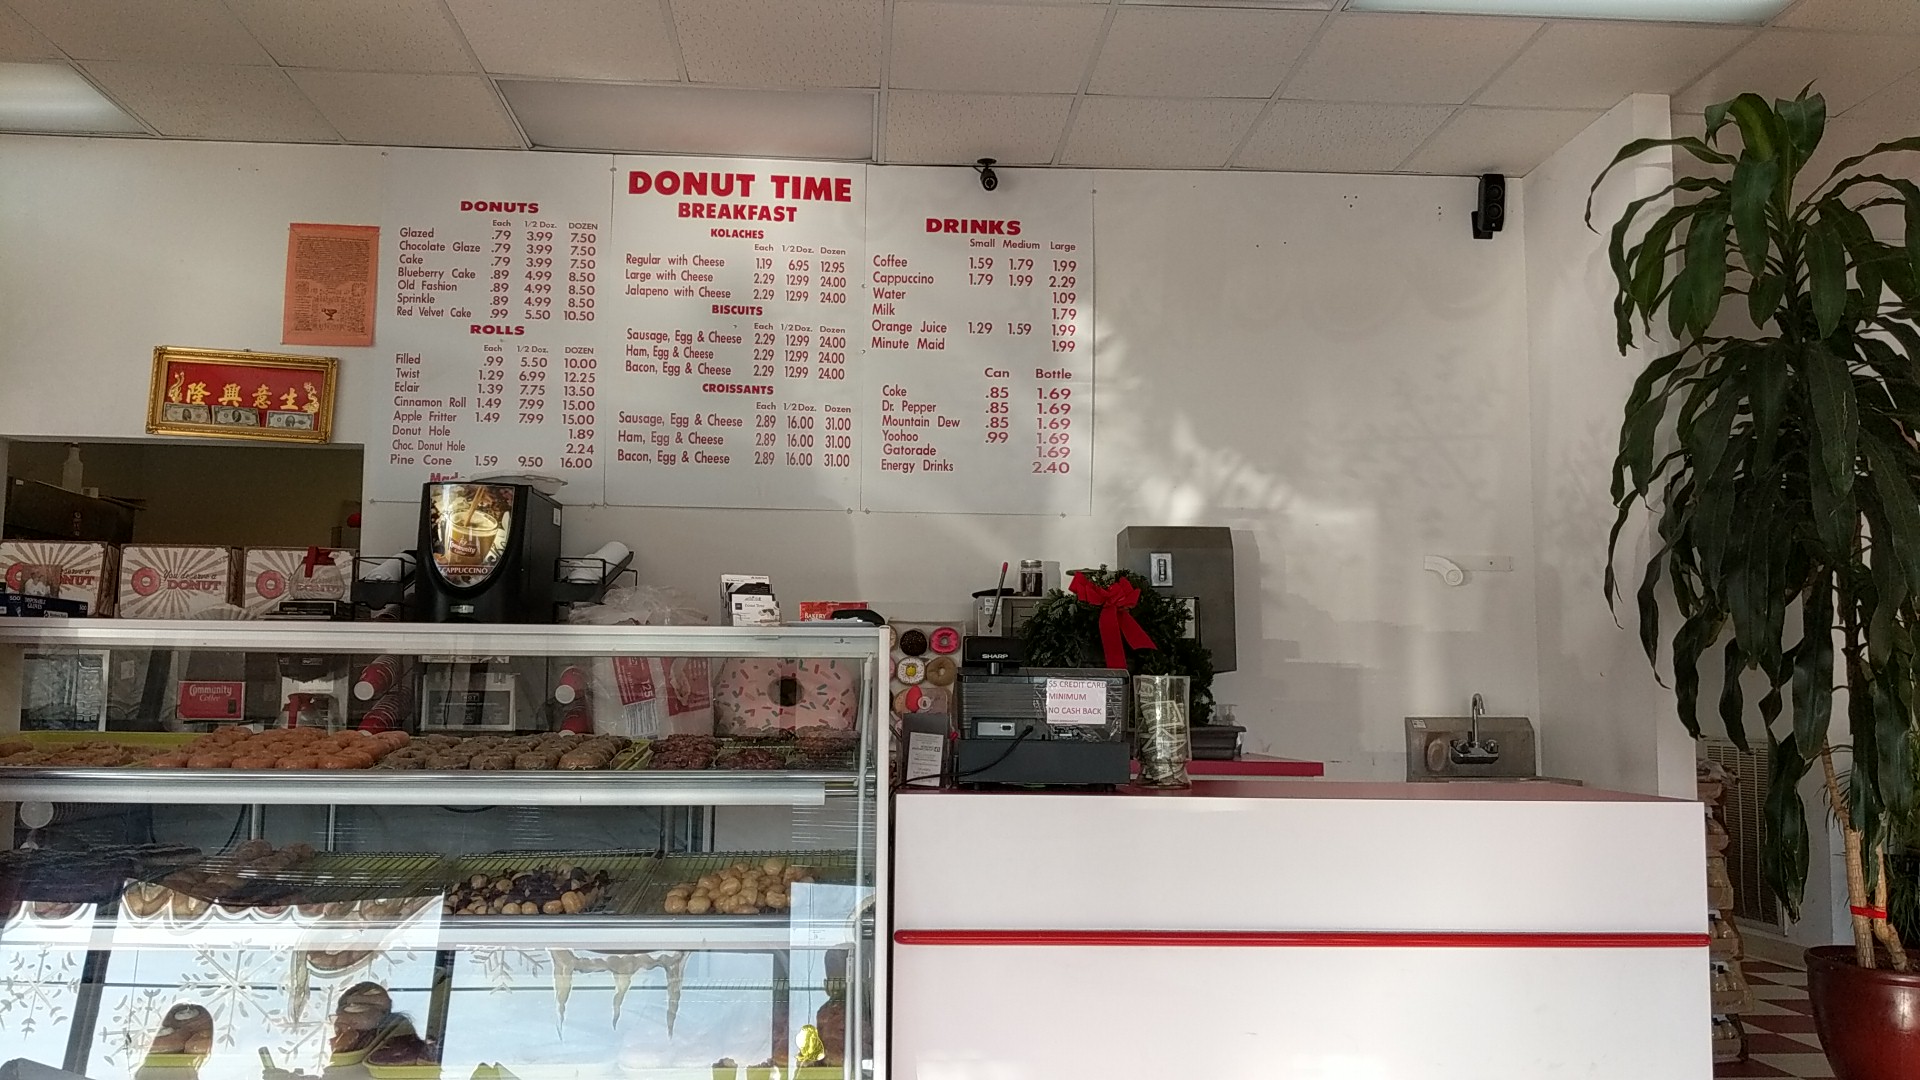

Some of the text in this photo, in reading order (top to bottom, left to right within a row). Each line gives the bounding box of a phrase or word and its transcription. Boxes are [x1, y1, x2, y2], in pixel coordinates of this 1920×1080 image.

[629, 171, 851, 202] DONUT TIME
[461, 201, 539, 213] DONUTS
[678, 203, 797, 222] BREAKFAST
[711, 229, 764, 239] KOLACHES
[926, 218, 1021, 235] DRINKS
[400, 227, 596, 243] Glazed .79 3.99 7.50
[821, 247, 845, 255] Dozen
[970, 238, 1076, 252] Small Medium Large
[626, 253, 844, 273] Regular with Cheese 1.19 6.95 12.95
[873, 254, 1076, 272] Coffee 1.59 1.79 1.99
[398, 267, 595, 282] Blueberry Cake .89 4.99 8.50
[873, 271, 1075, 288] Cappuccino 1.79 1.99 2.29
[625, 284, 846, 303] Jalapeno with Cheese 2.29 12.99 24.00
[873, 287, 1076, 304] Water 1.09
[397, 306, 594, 321] Red Velvet Cake .99 5.50 10.50
[712, 305, 762, 316] BISCUITS
[470, 325, 524, 335] ROLLS
[627, 328, 846, 348] Sausage, Egg & Cheese 2.29 12.99 24.00
[396, 353, 597, 369] Filled .99 5.50 10.00
[626, 360, 844, 380] Bacon, Egg & Cheese 2.29 12.99 24.00
[985, 368, 1072, 379] Can Bottle
[395, 381, 594, 396] Eclair 1.39 7.75 13.50
[703, 383, 773, 395] CROISSANTS
[883, 384, 1071, 399] Coke .85 1.69
[394, 396, 595, 411] Cinnamon Roll 1.49 7.99 15.00
[882, 400, 1071, 414] Dr. Pepper .85 1.69
[619, 411, 851, 431] Sausage, Egg & Cheese 2.89 16.00 31.00
[392, 425, 594, 439] Donut Hole 1.89
[618, 430, 851, 449] Ham, Egg & Cheese 2.89 16.00 31.00
[882, 429, 1069, 444] Yoohoo .99 1.69
[390, 454, 592, 468] Pine Cone 1.59 9.50 16.00
[882, 459, 1069, 473] Energy Drinks 2.40
[60, 575, 94, 585] NUT
[167, 580, 221, 590] DONUT
[189, 684, 232, 697] Community
[1048, 693, 1087, 701] MINIMUM
[1062, 707, 1081, 715] CASH
[1082, 708, 1102, 716] BACK
